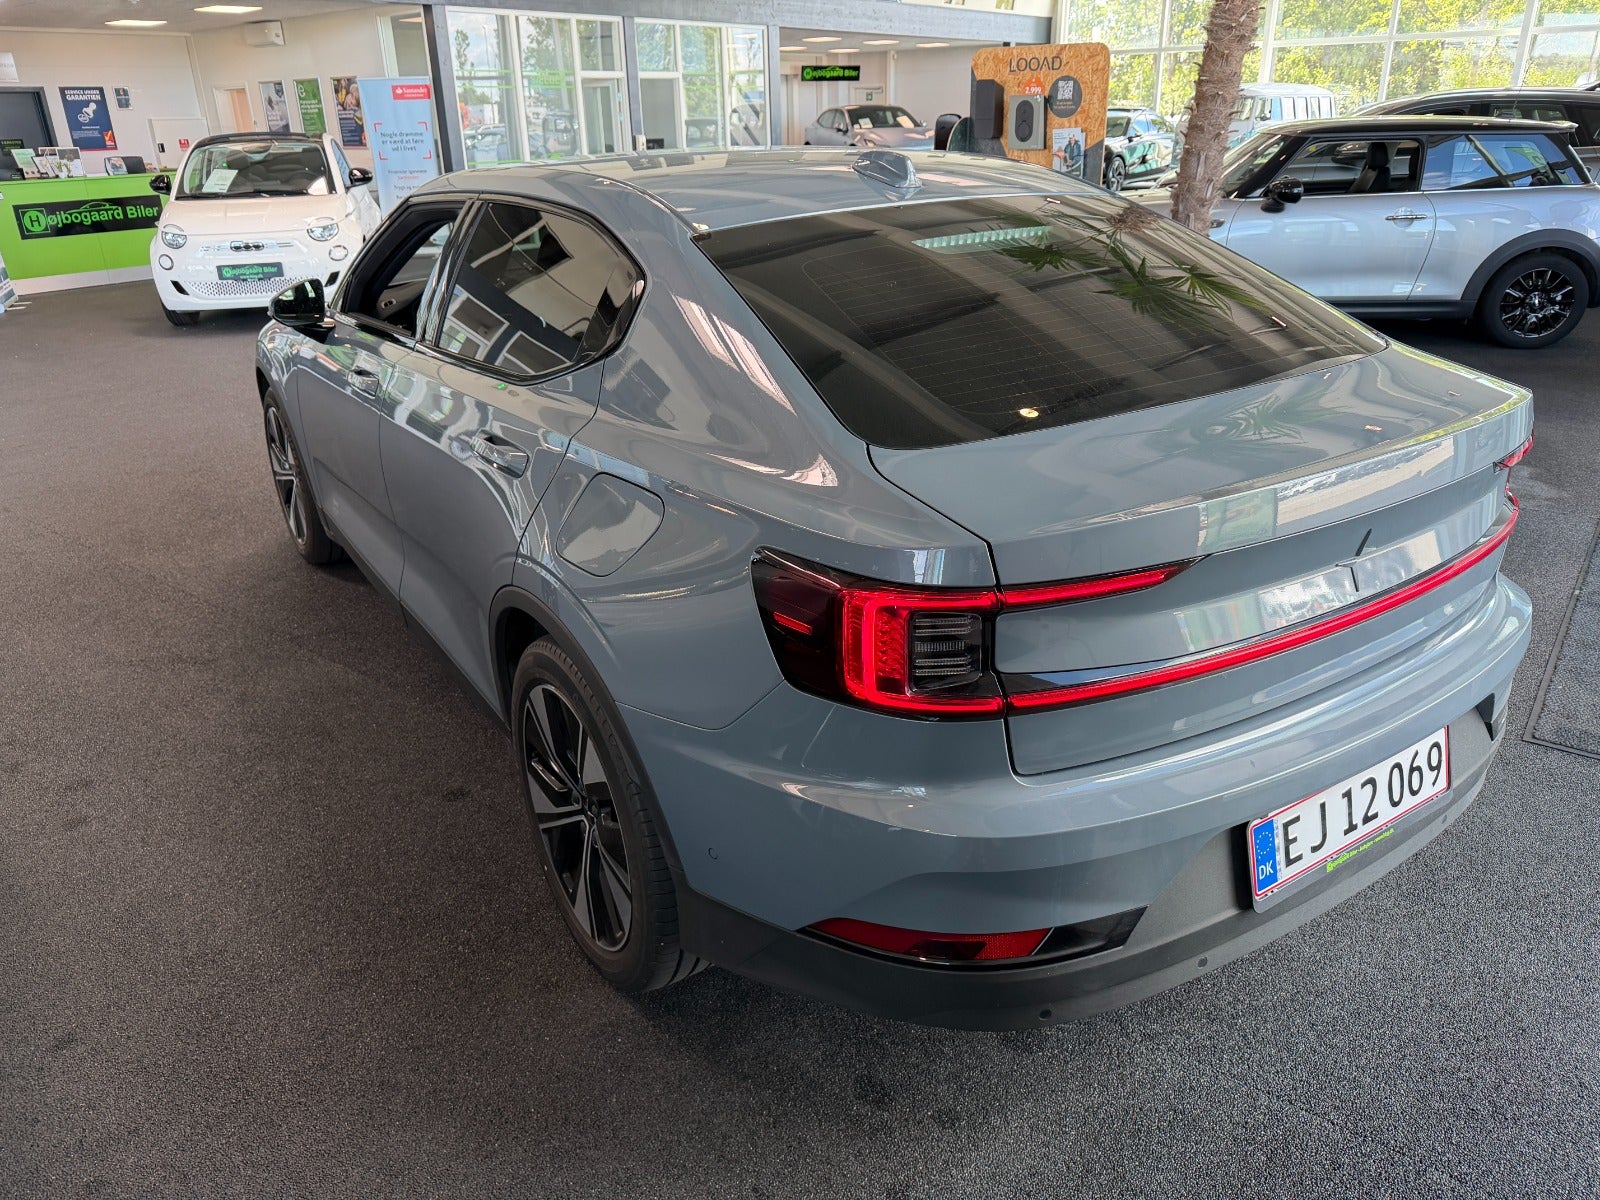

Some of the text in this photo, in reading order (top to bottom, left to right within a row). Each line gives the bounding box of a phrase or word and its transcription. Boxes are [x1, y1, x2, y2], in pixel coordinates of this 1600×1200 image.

[844, 69, 859, 77] Biler
[1009, 56, 1062, 72] LOOAD
[22, 205, 159, 232] Højbogaard Biler
[1258, 864, 1274, 880] DK
[1282, 801, 1328, 868] EJ
[1341, 776, 1379, 836] 12
[1388, 741, 1443, 808] 069
